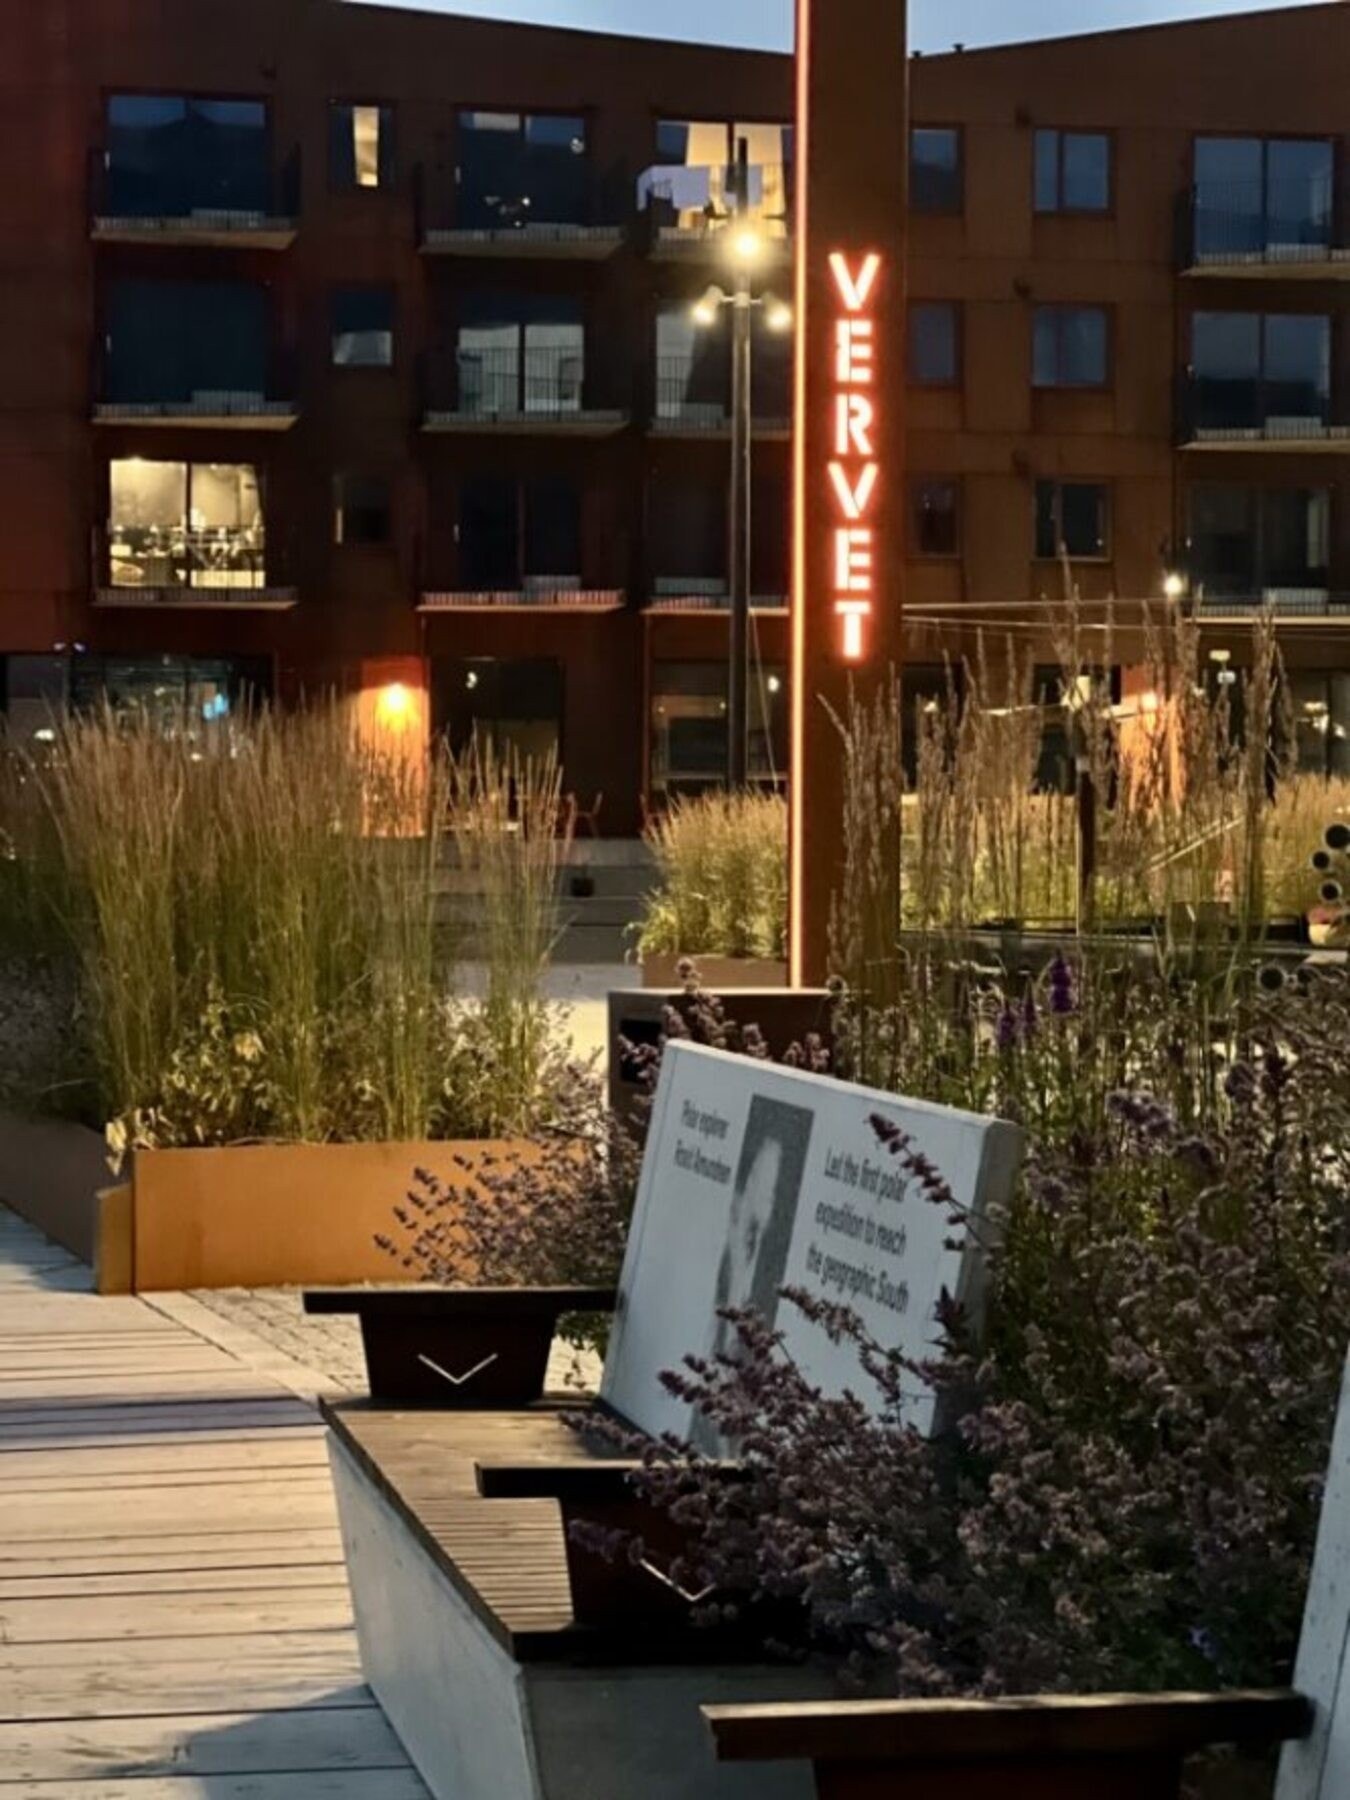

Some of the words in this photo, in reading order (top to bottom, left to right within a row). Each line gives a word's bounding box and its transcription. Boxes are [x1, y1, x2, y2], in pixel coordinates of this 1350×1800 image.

[827, 252, 882, 659] VERVET
[842, 1152, 860, 1187] the
[860, 1158, 881, 1194] first
[878, 1168, 908, 1203] polar
[864, 1216, 877, 1245] to
[876, 1223, 907, 1256] reach
[806, 1242, 823, 1275] the
[821, 1254, 877, 1299] geographic
[876, 1270, 909, 1314] South
